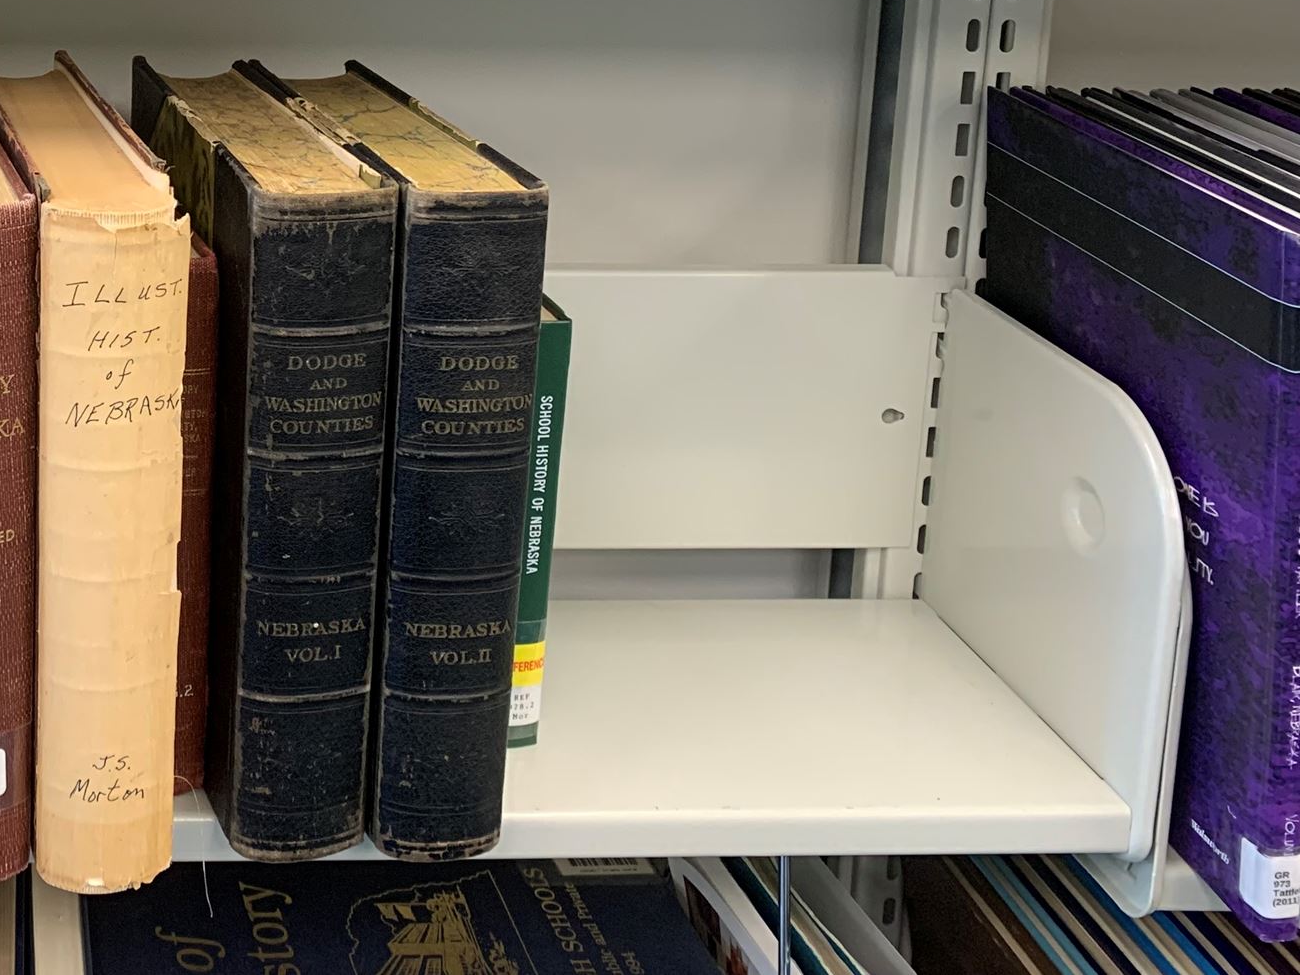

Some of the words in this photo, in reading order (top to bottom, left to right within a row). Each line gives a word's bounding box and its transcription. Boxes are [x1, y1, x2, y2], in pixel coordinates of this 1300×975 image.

[287, 353, 367, 371] DODGE
[309, 377, 347, 390] AND
[264, 391, 382, 412] WASHINGTON
[416, 392, 533, 412] WASHINGTON
[269, 414, 374, 436] COUNTIES
[537, 394, 554, 442] SCHOOL
[534, 445, 550, 494] HISTORY
[532, 497, 545, 513] OF
[525, 516, 542, 576] NEBRASKA
[257, 616, 367, 639] NEBRASKA
[70, 778, 145, 804] Morton
[1274, 871, 1290, 879] GR
